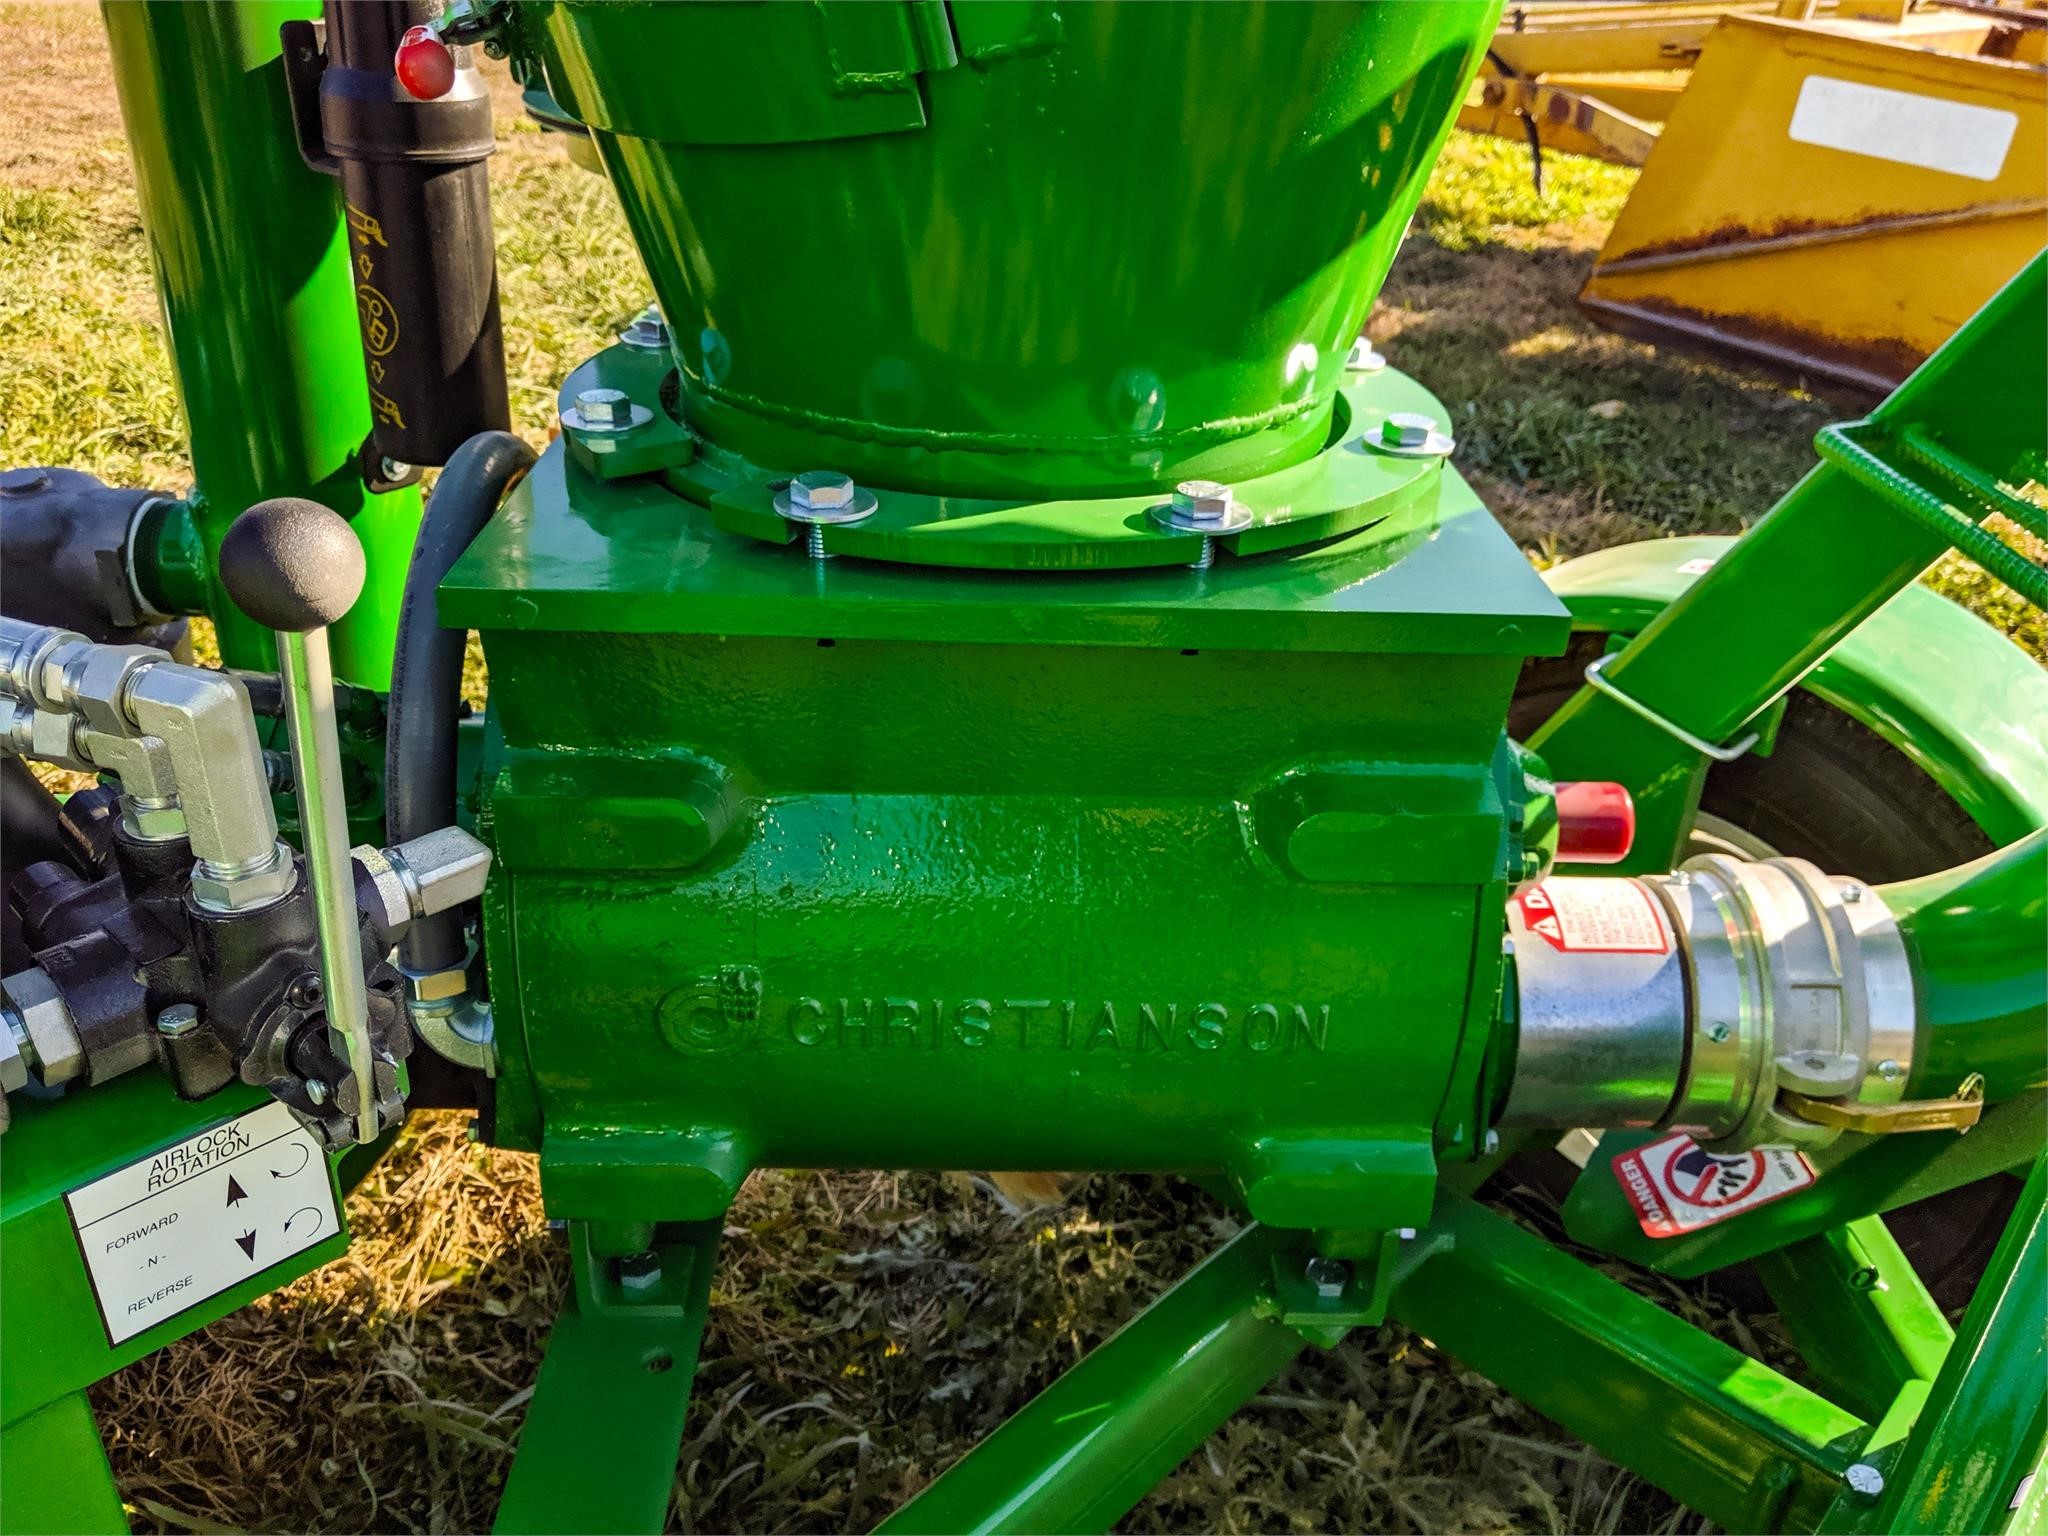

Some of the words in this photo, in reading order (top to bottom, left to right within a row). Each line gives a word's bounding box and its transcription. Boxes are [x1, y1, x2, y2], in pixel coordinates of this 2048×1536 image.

[790, 996, 1330, 1051] CHRISTIANSON
[147, 1133, 250, 1192] ROTATION
[150, 1122, 241, 1175] AIRLOCK
[1620, 1158, 1665, 1223] DANGER
[105, 1212, 179, 1254] FORWARD
[127, 1275, 193, 1315] REVERSE
